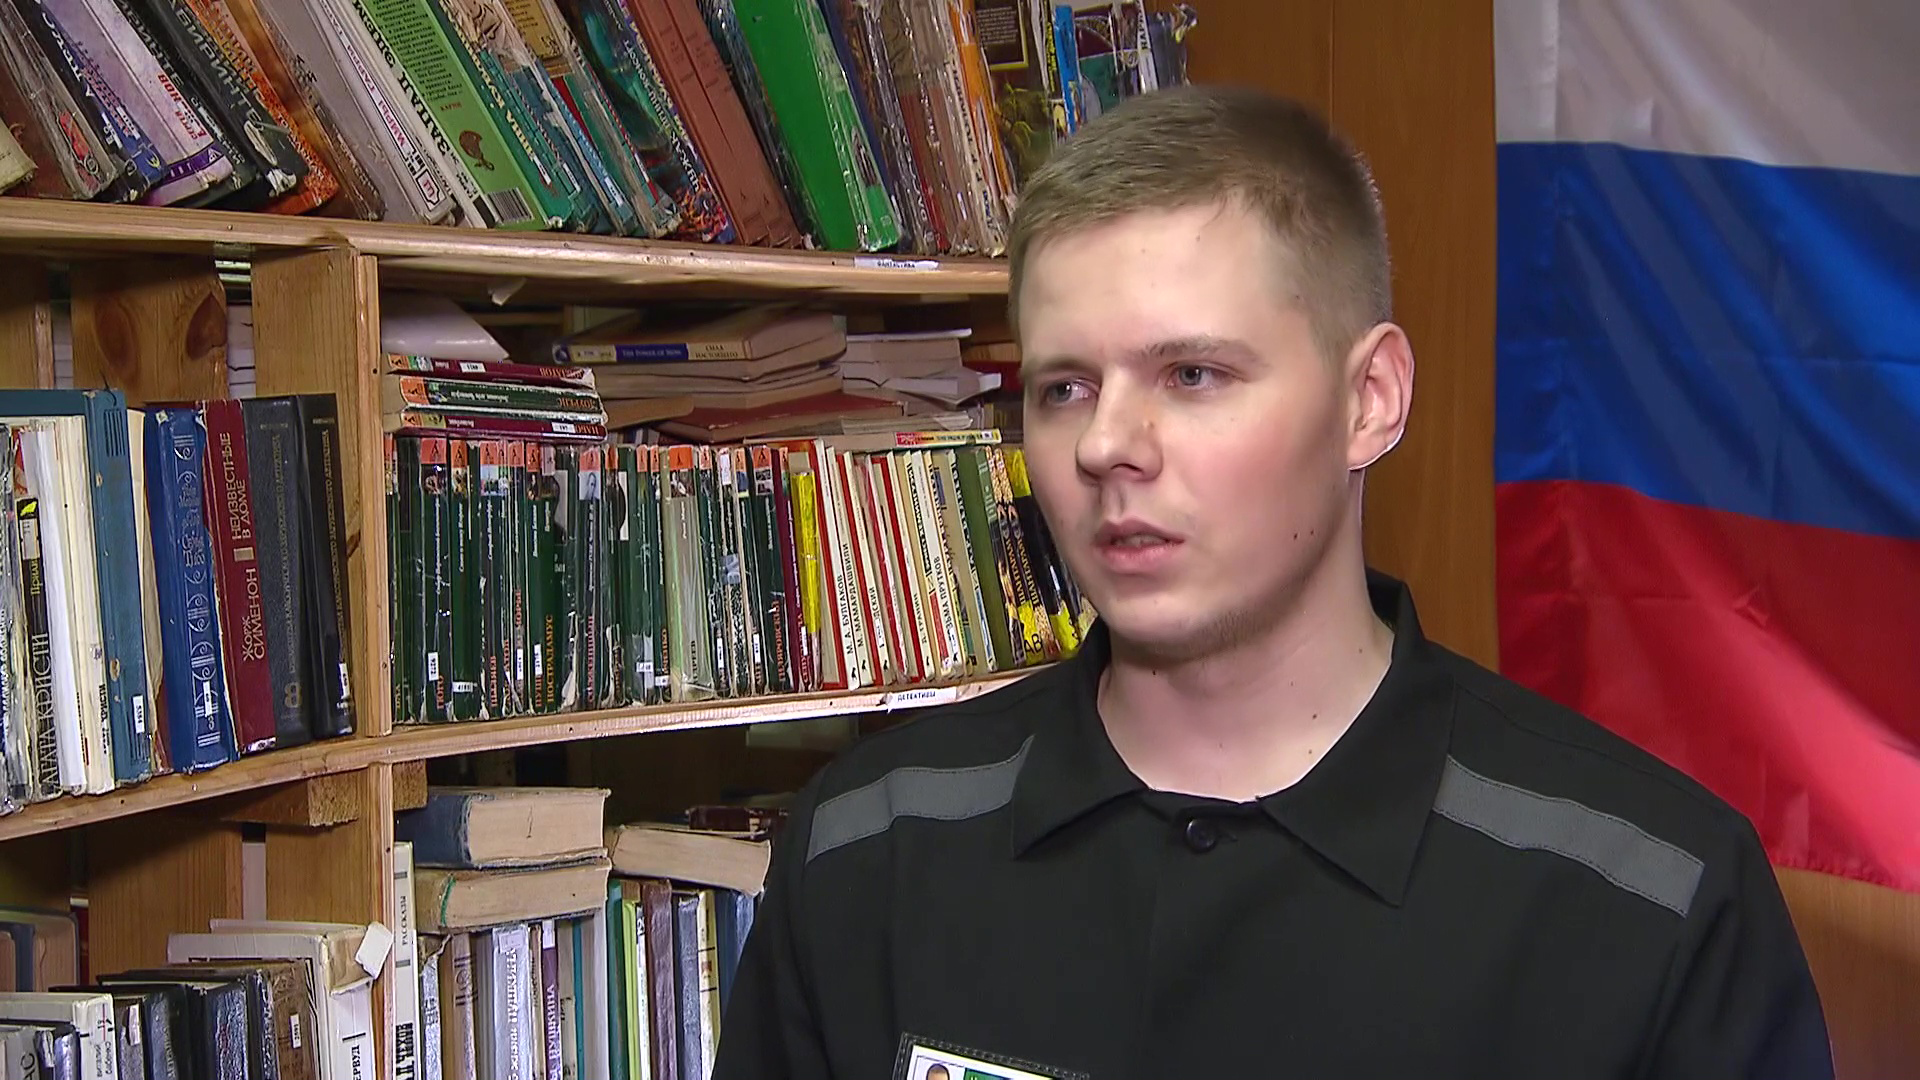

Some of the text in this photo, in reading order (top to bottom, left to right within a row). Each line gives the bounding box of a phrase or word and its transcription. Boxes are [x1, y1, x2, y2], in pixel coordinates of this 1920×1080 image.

[220, 432, 242, 540] НЕИЗВЕСТНЫЕ
[236, 479, 252, 539] В ДОМЕ
[837, 575, 850, 626] БУЛГАКОВ
[843, 543, 865, 648] М. МАМАРДАШВИЛИ
[934, 556, 948, 599] ПРУТКОВ
[1004, 539, 1026, 604] ШАНТАРАМ
[1017, 538, 1040, 604] ШАНТАРАМ
[246, 567, 265, 660] СИМЕНОН
[913, 593, 925, 631] ГРАНИН
[546, 615, 554, 702] НОСТРАДАМУС
[846, 642, 855, 655] М.
[32, 632, 60, 784] АГАТА КРИСТИ
[399, 896, 409, 946] РАССКАЗЫ
[547, 984, 558, 1060] ПУШКИНА
